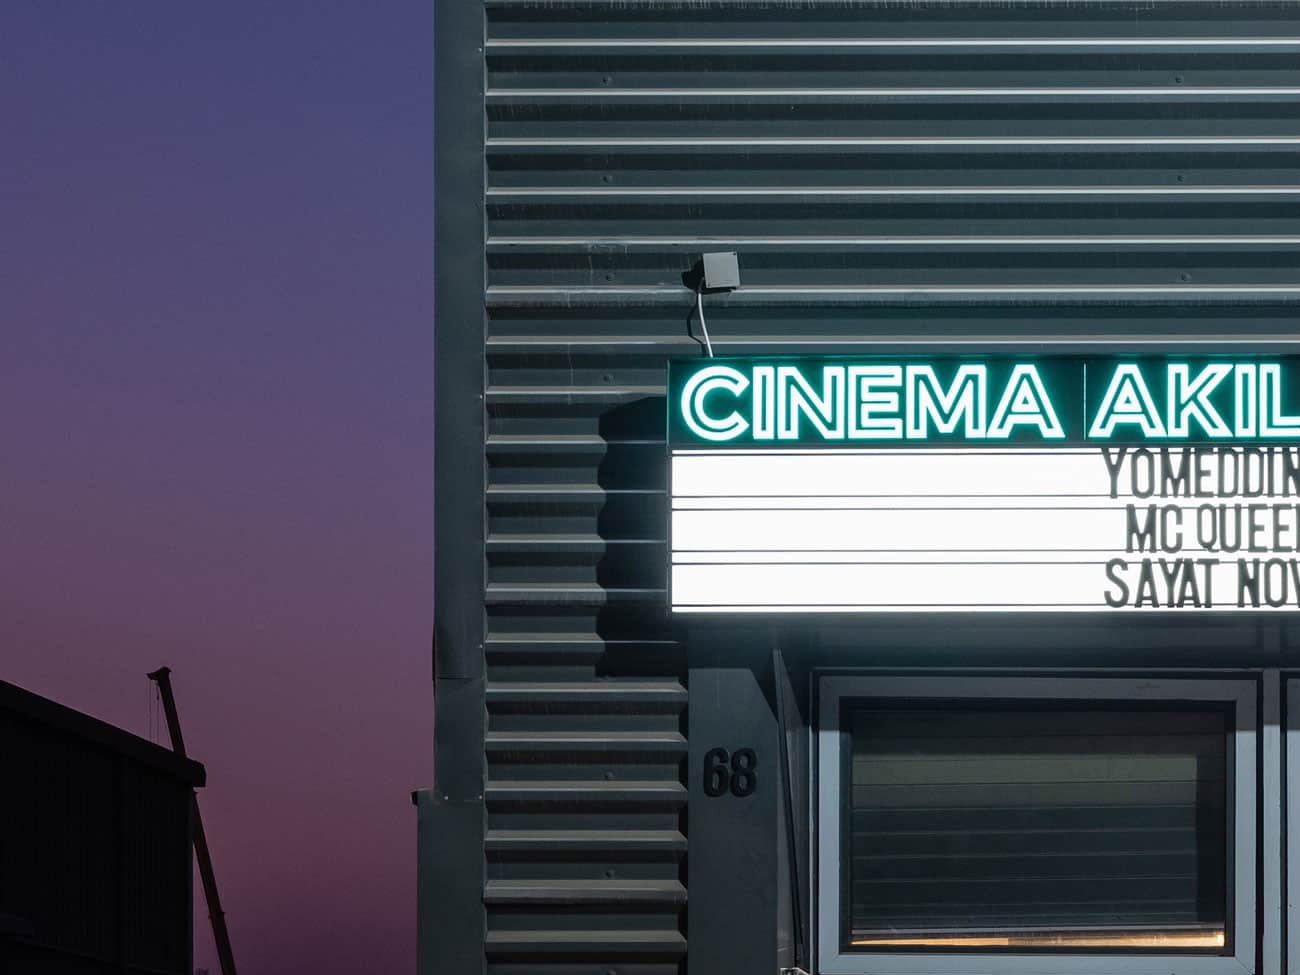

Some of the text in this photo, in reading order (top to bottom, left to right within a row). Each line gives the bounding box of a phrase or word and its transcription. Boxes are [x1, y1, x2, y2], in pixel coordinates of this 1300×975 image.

[680, 363, 1066, 441] CINEMA
[1126, 503, 1183, 553] MC
[1104, 557, 1220, 608] SAYAT
[703, 747, 758, 798] 68
